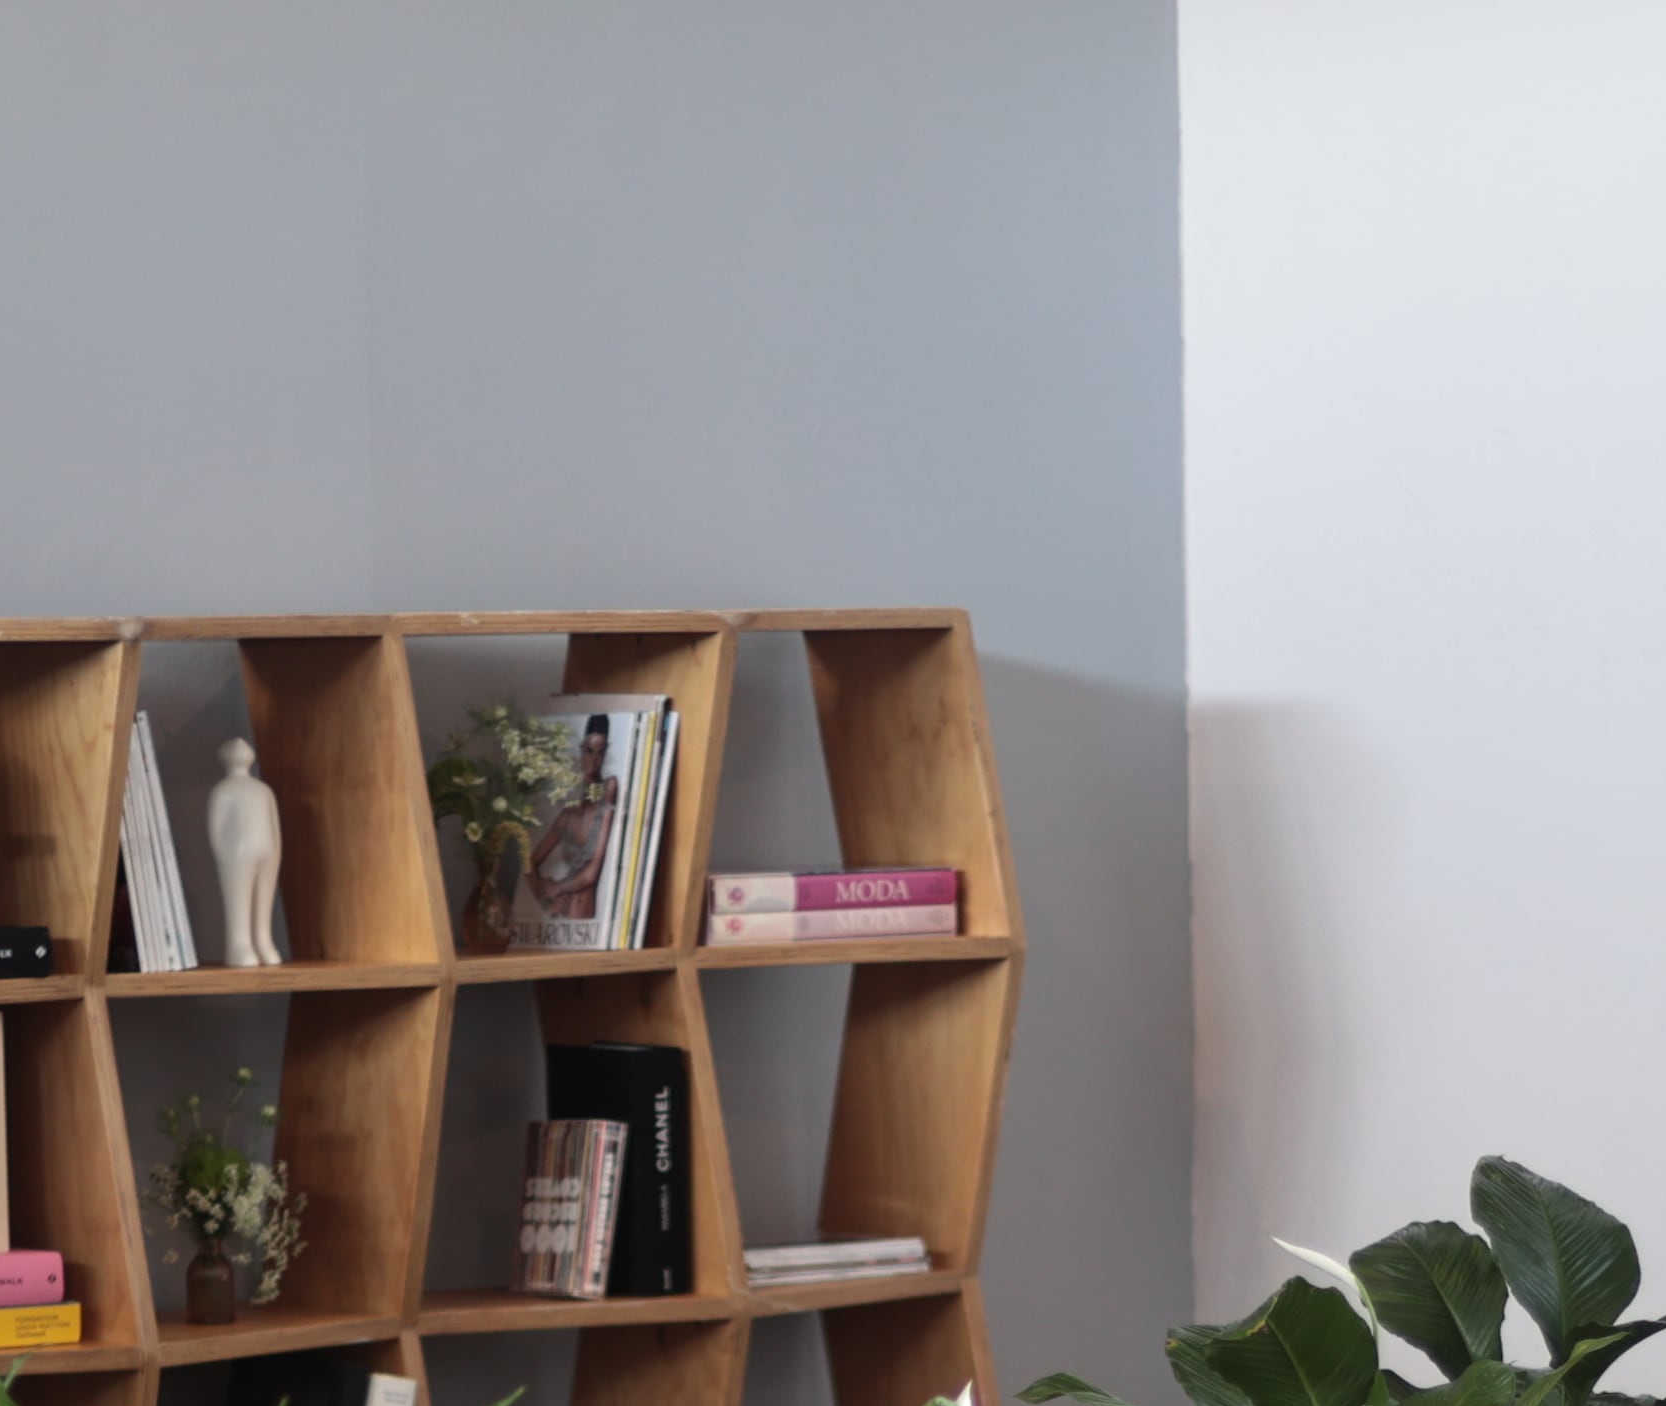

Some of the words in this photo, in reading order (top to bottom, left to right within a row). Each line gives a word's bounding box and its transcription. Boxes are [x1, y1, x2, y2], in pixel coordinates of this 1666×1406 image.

[835, 879, 910, 903] MODA
[834, 910, 910, 931] MODA
[510, 921, 599, 946] SWAROVSKI
[654, 1086, 671, 1173] CHANEL
